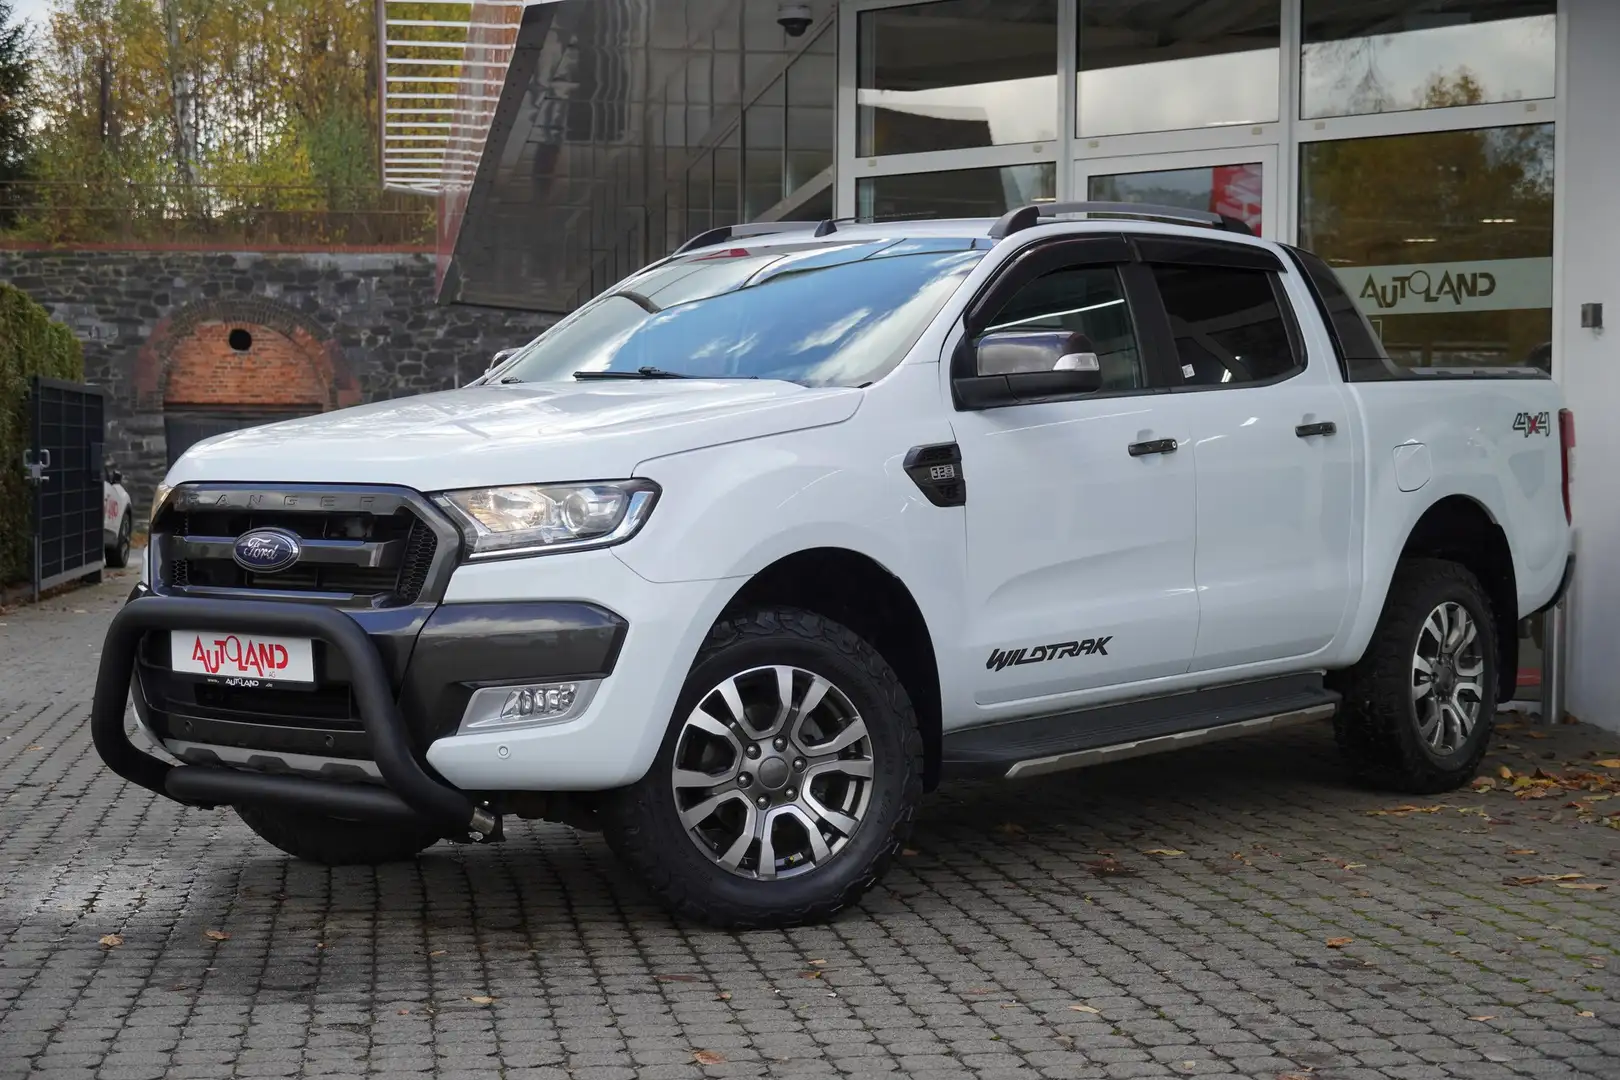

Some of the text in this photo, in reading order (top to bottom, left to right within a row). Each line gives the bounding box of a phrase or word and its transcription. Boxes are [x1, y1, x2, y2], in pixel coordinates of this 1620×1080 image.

[1359, 270, 1496, 308] AUTOLAND
[243, 537, 280, 560] Ford
[192, 635, 289, 677] AUTOLAND
[986, 636, 1113, 672] WILDTRAK
[225, 677, 260, 687] AUTOLAND
